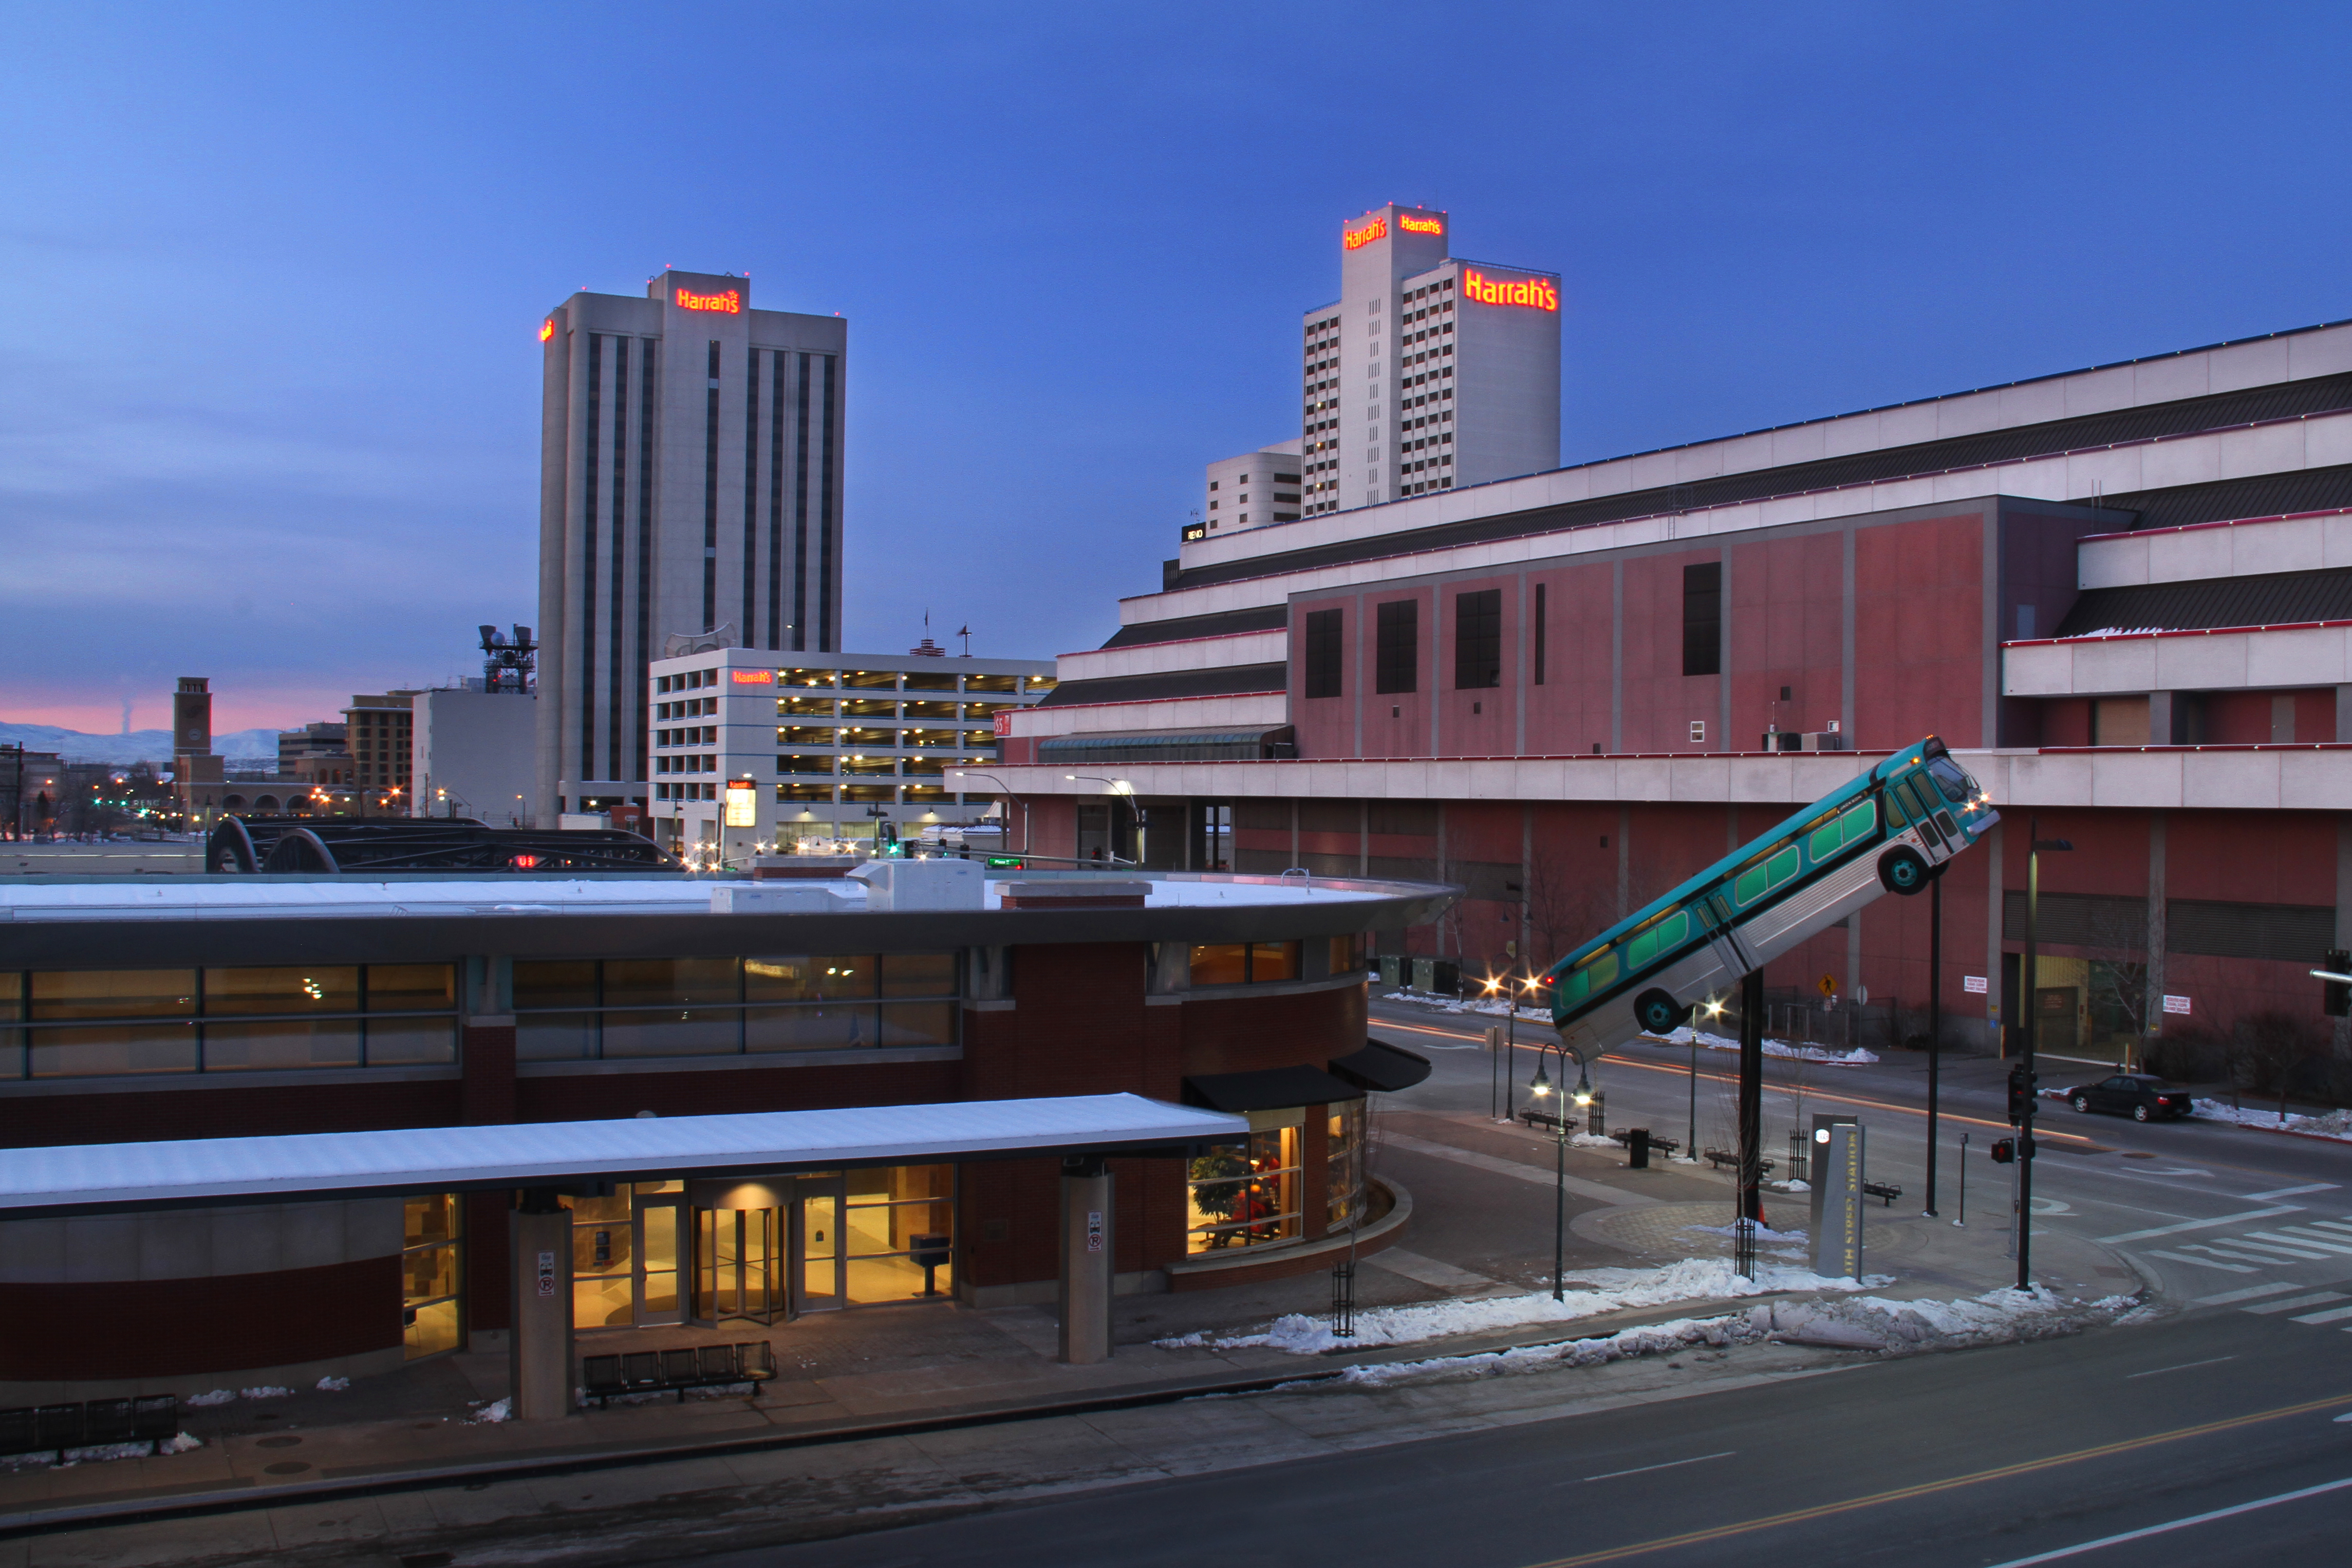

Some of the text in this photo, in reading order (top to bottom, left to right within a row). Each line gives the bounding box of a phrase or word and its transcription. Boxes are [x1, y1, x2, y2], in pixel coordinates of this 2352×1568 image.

[1465, 268, 1558, 311] Harrah's
[1845, 1131, 1857, 1192] STATION
[1845, 1195, 1856, 1244] STREET
